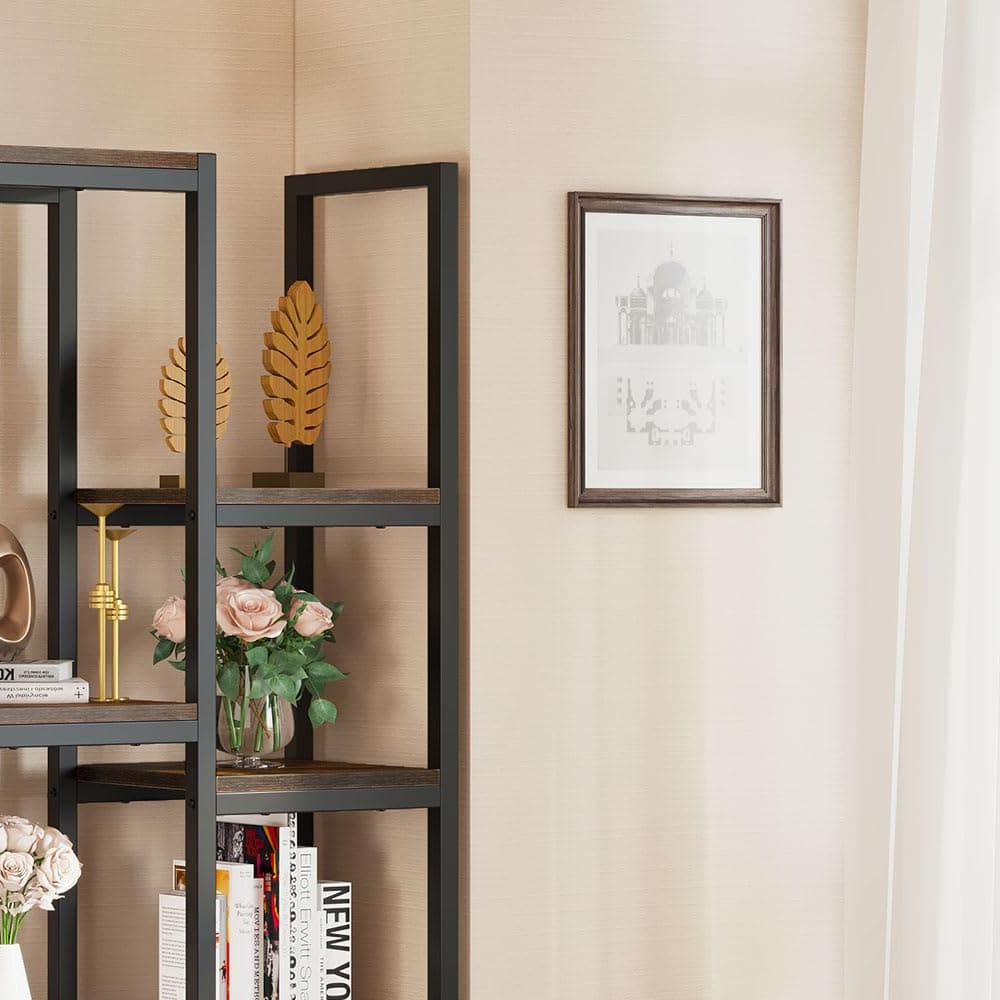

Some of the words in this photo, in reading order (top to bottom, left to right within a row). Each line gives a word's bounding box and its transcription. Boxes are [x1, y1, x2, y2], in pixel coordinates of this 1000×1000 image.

[299, 853, 313, 901] Elliott
[299, 908, 313, 959] Erwitt
[323, 885, 350, 952] NEW
